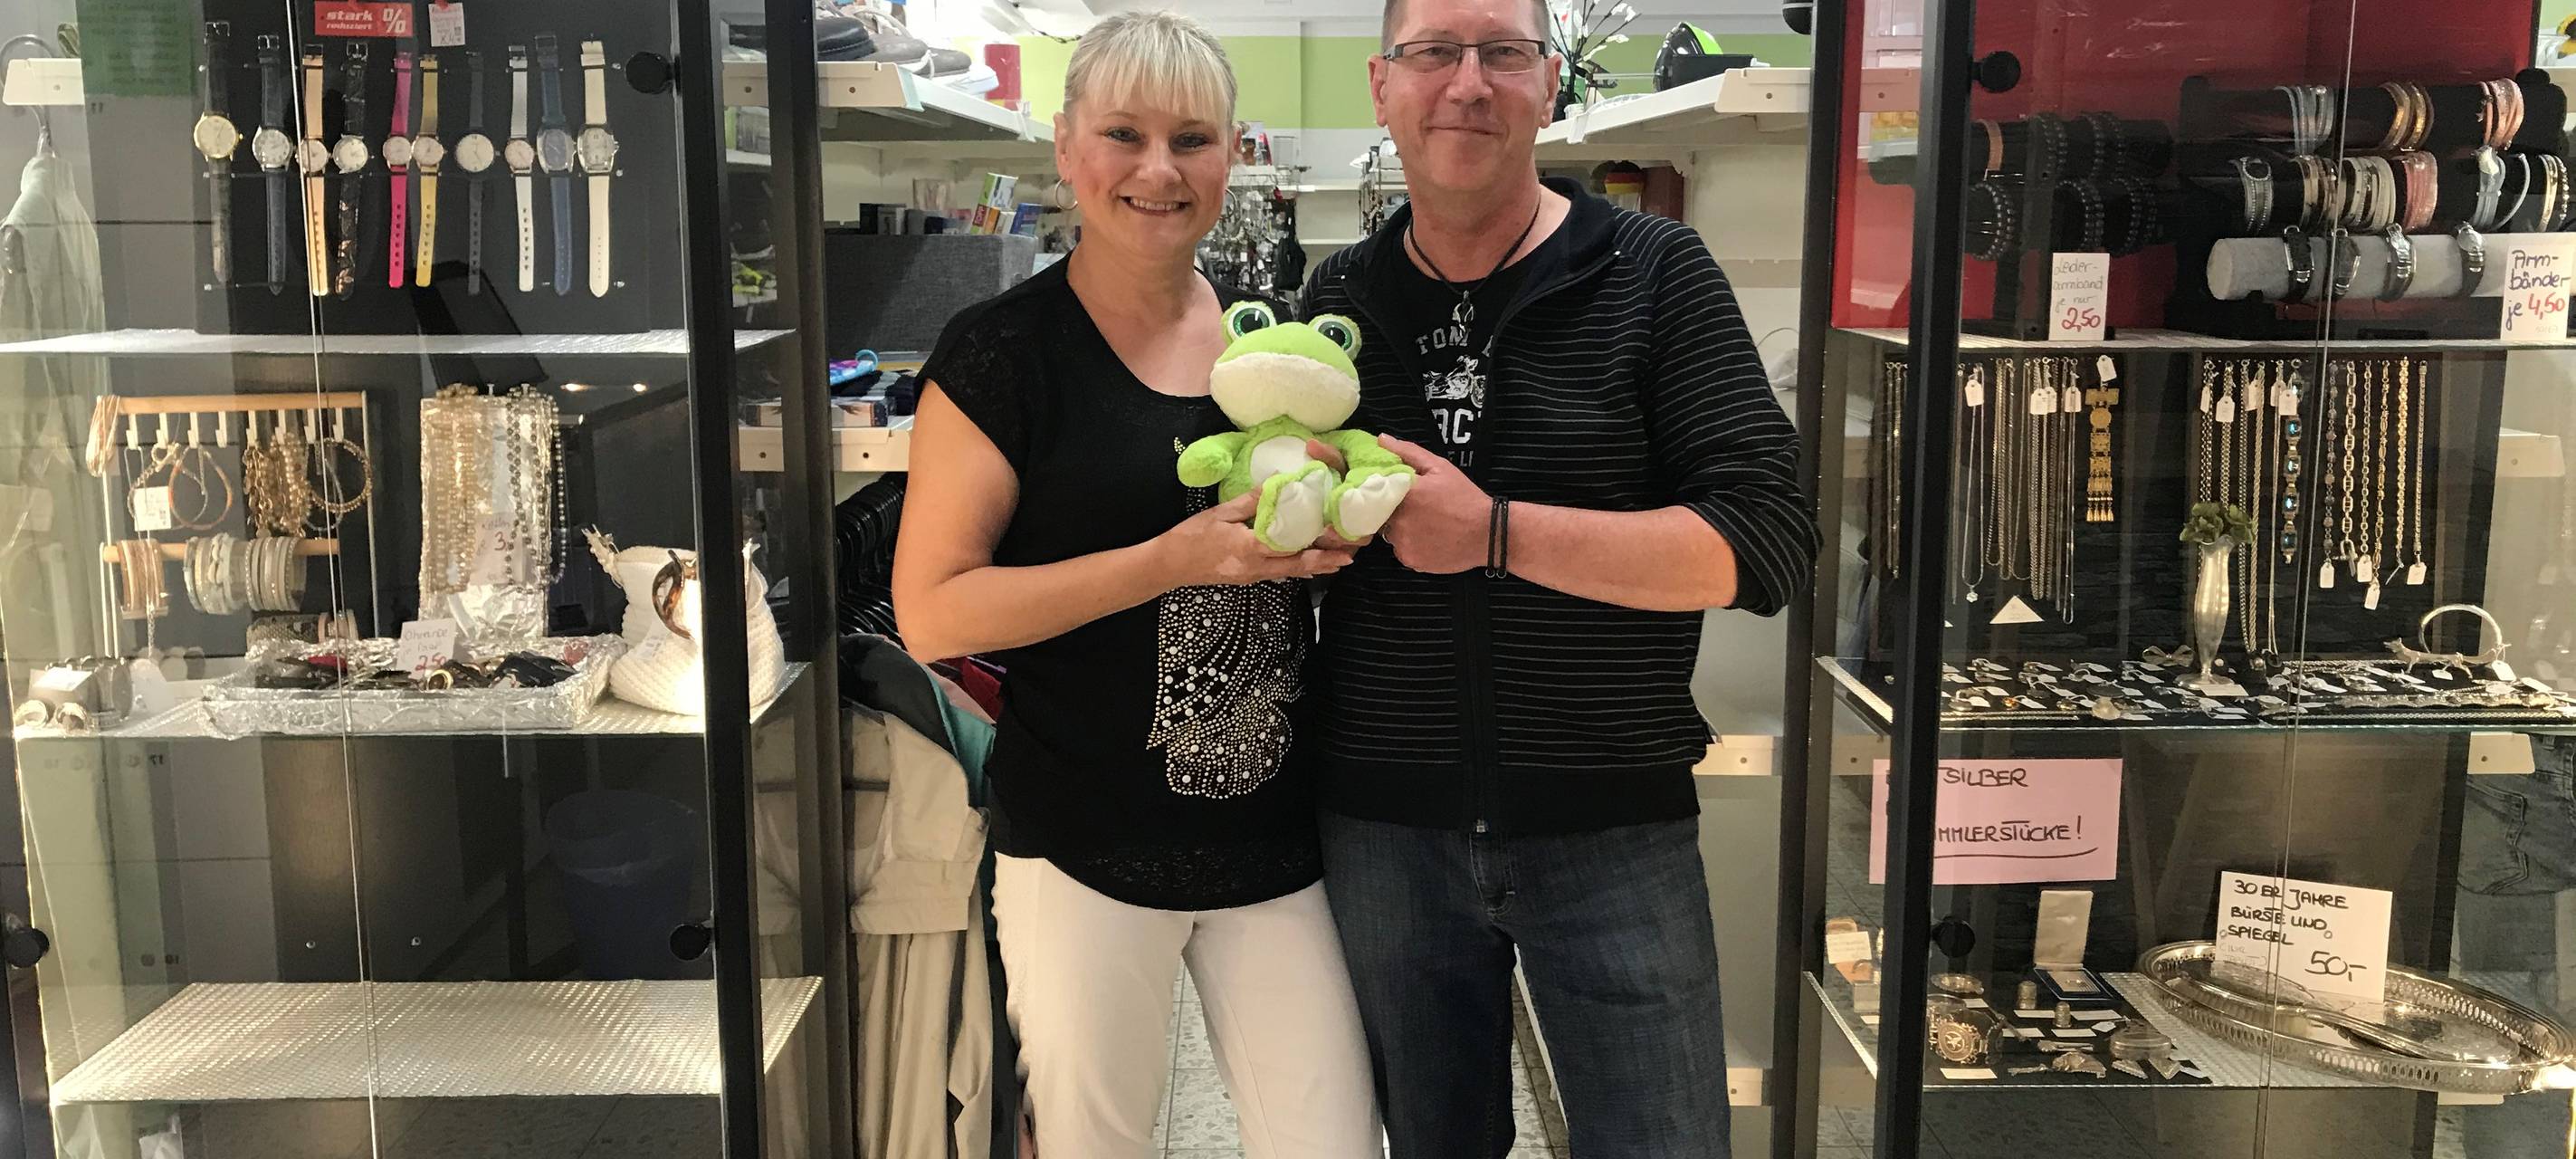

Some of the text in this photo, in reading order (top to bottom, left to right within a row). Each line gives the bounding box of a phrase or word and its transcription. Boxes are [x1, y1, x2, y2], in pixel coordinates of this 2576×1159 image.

[326, 10, 374, 22] stark
[326, 23, 373, 31] reduziert
[2053, 257, 2098, 276] Leder-
[2512, 249, 2559, 269] Arm-
[2508, 268, 2571, 291] bänder
[2061, 307, 2101, 332] 2,50
[2505, 292, 2566, 331] je 4,50
[1935, 815, 2082, 843] MMLERSTÜCKE!
[2282, 888, 2350, 911] JAHRE
[2230, 905, 2328, 931] BÜRSTE UND
[2228, 924, 2295, 946] SPIEGEL
[2304, 950, 2368, 982] 50,-
